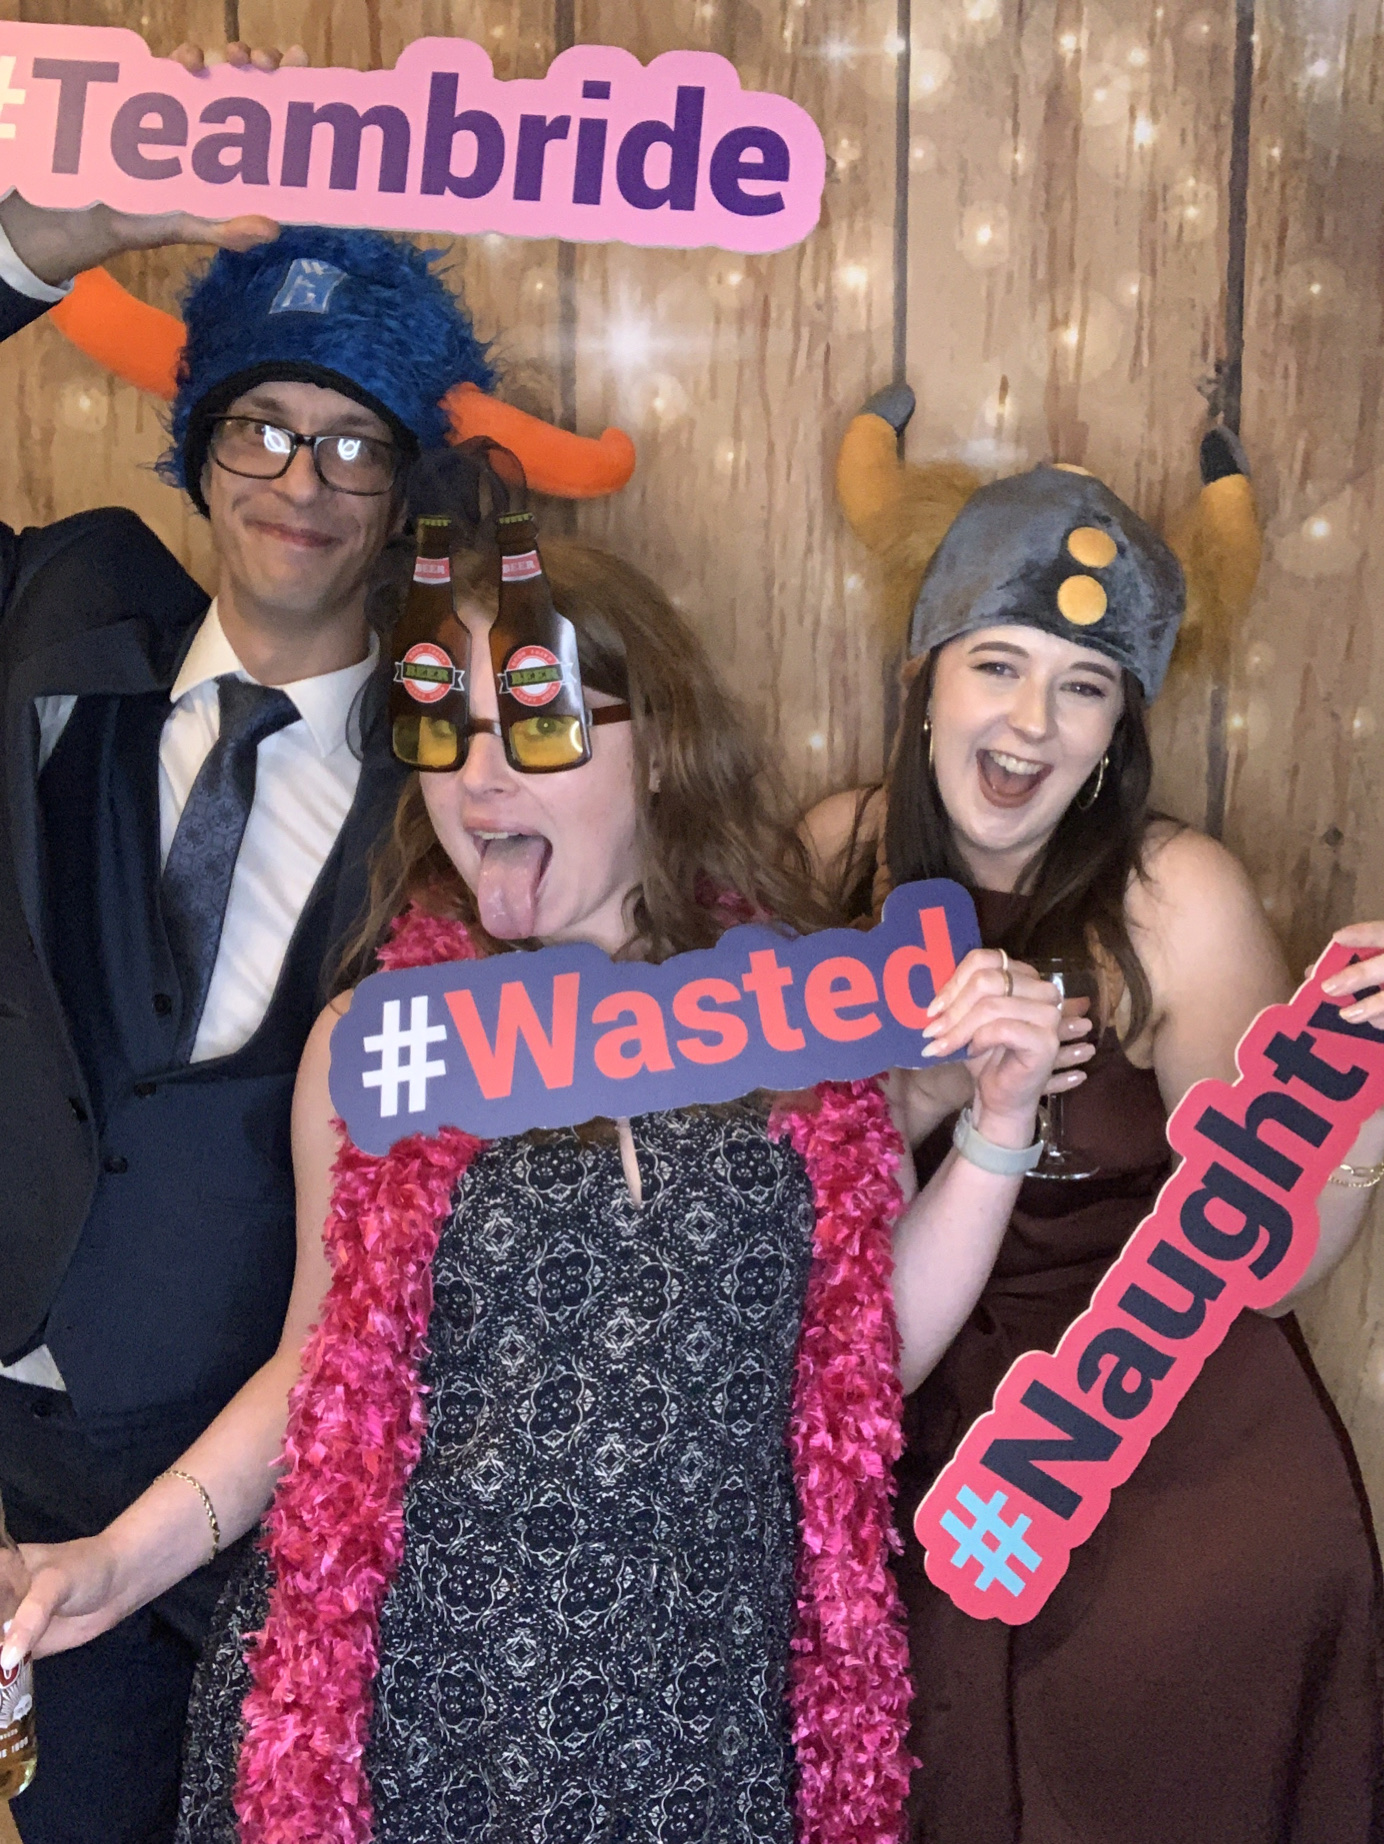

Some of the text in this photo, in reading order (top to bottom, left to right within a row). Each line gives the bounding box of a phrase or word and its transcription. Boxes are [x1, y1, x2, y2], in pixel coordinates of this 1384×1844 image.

[415, 563, 445, 575] BEER
[502, 560, 535, 574] BEER
[362, 906, 957, 1117] #Wasted
